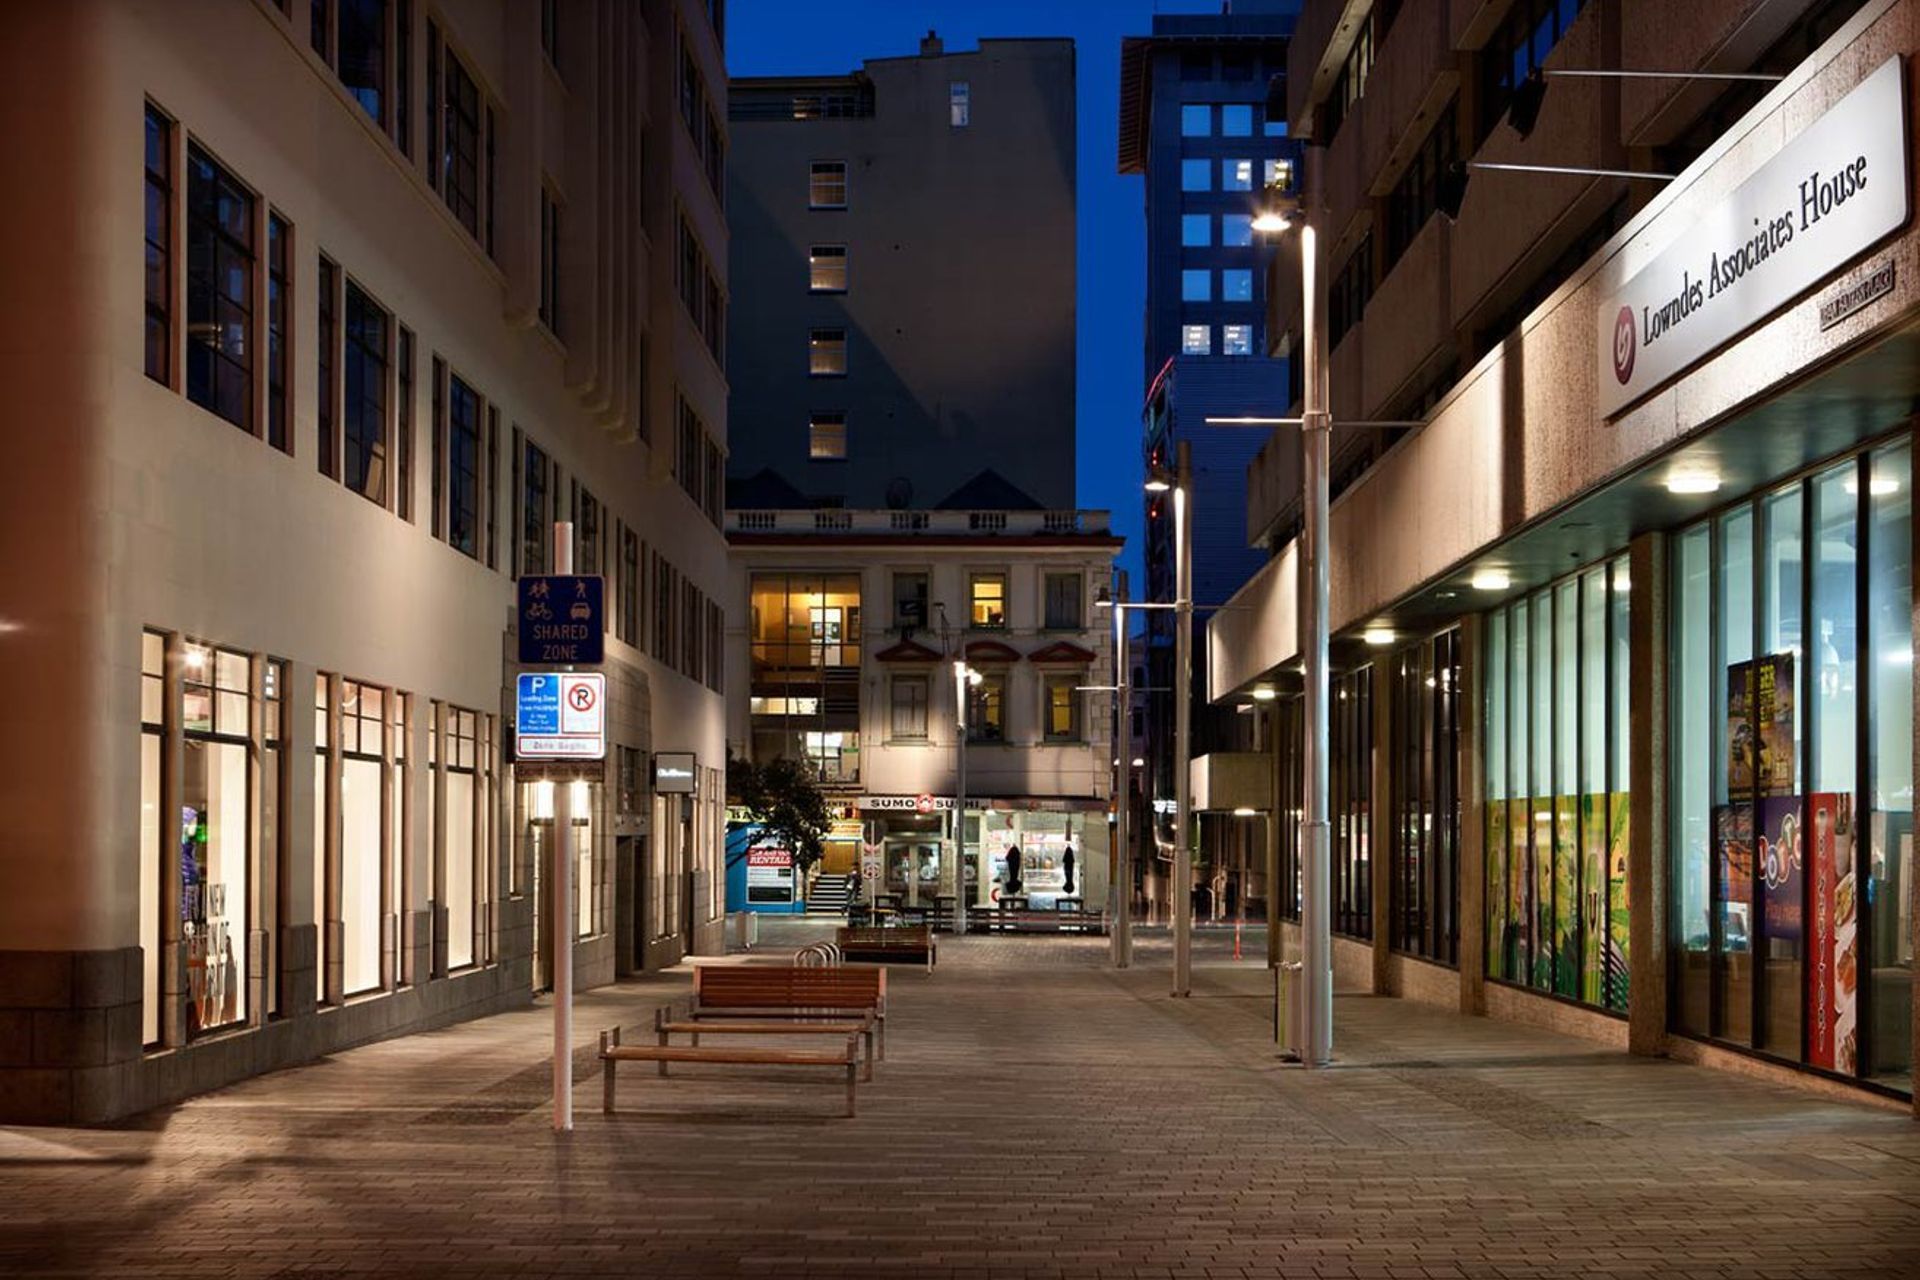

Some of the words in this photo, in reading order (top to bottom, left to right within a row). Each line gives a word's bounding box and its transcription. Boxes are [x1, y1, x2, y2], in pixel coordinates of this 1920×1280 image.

[1643, 271, 1703, 346] Lowndes
[1708, 211, 1793, 298] Associates
[1799, 154, 1868, 231] House
[532, 624, 589, 640] SHARED
[542, 644, 579, 660] ZONE
[532, 677, 546, 693] P
[871, 799, 915, 808] SUMO
[749, 856, 791, 864] RENTALS
